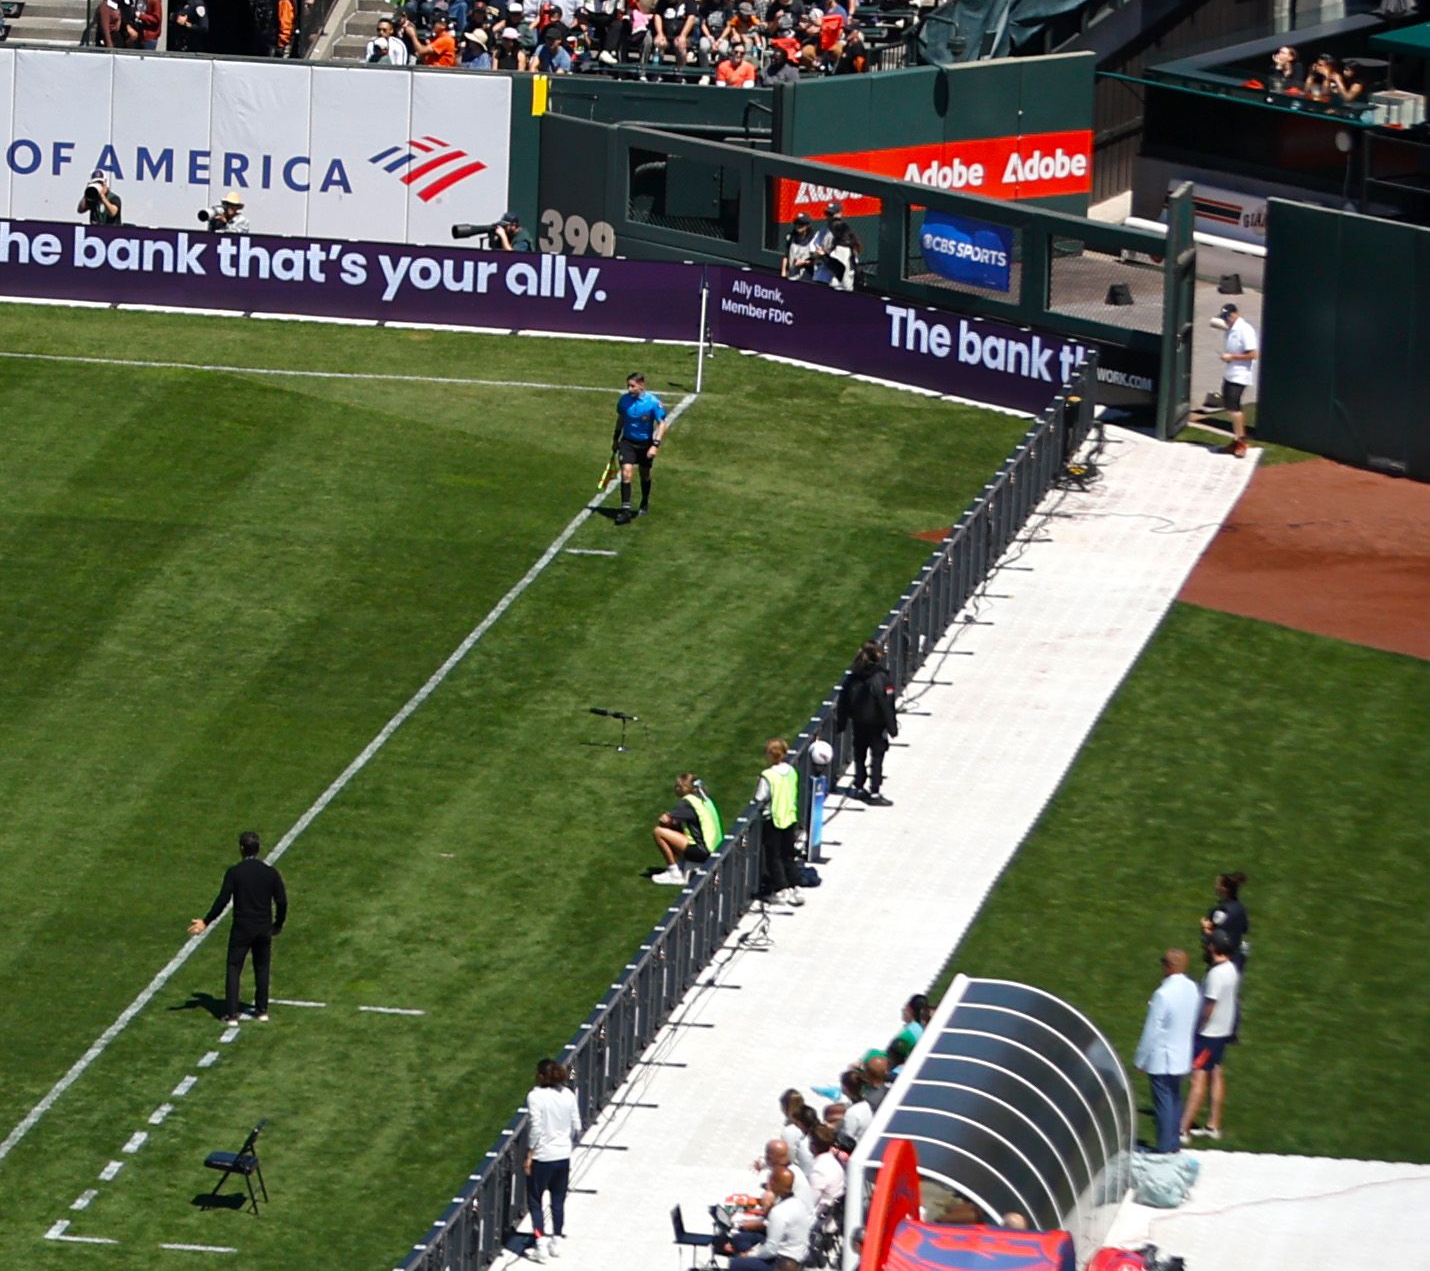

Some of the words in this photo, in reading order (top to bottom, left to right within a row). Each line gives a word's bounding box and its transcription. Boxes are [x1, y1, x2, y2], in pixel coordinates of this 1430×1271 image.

[6, 138, 74, 177] OF
[93, 143, 353, 195] AMERICA
[904, 158, 985, 189] Adobe
[1002, 148, 1087, 184] Adobe
[540, 209, 615, 258] 399
[931, 235, 957, 256] CBS
[956, 238, 1007, 268] SPORTS
[73, 227, 208, 276] bank
[217, 237, 367, 286] that's
[378, 255, 498, 302] your
[506, 253, 607, 312] ally.
[732, 280, 753, 299] Ally
[754, 285, 785, 305] Bank,
[721, 297, 766, 320] Member
[768, 308, 794, 326] FDIC
[885, 305, 952, 359] The
[958, 317, 1054, 384] bank
